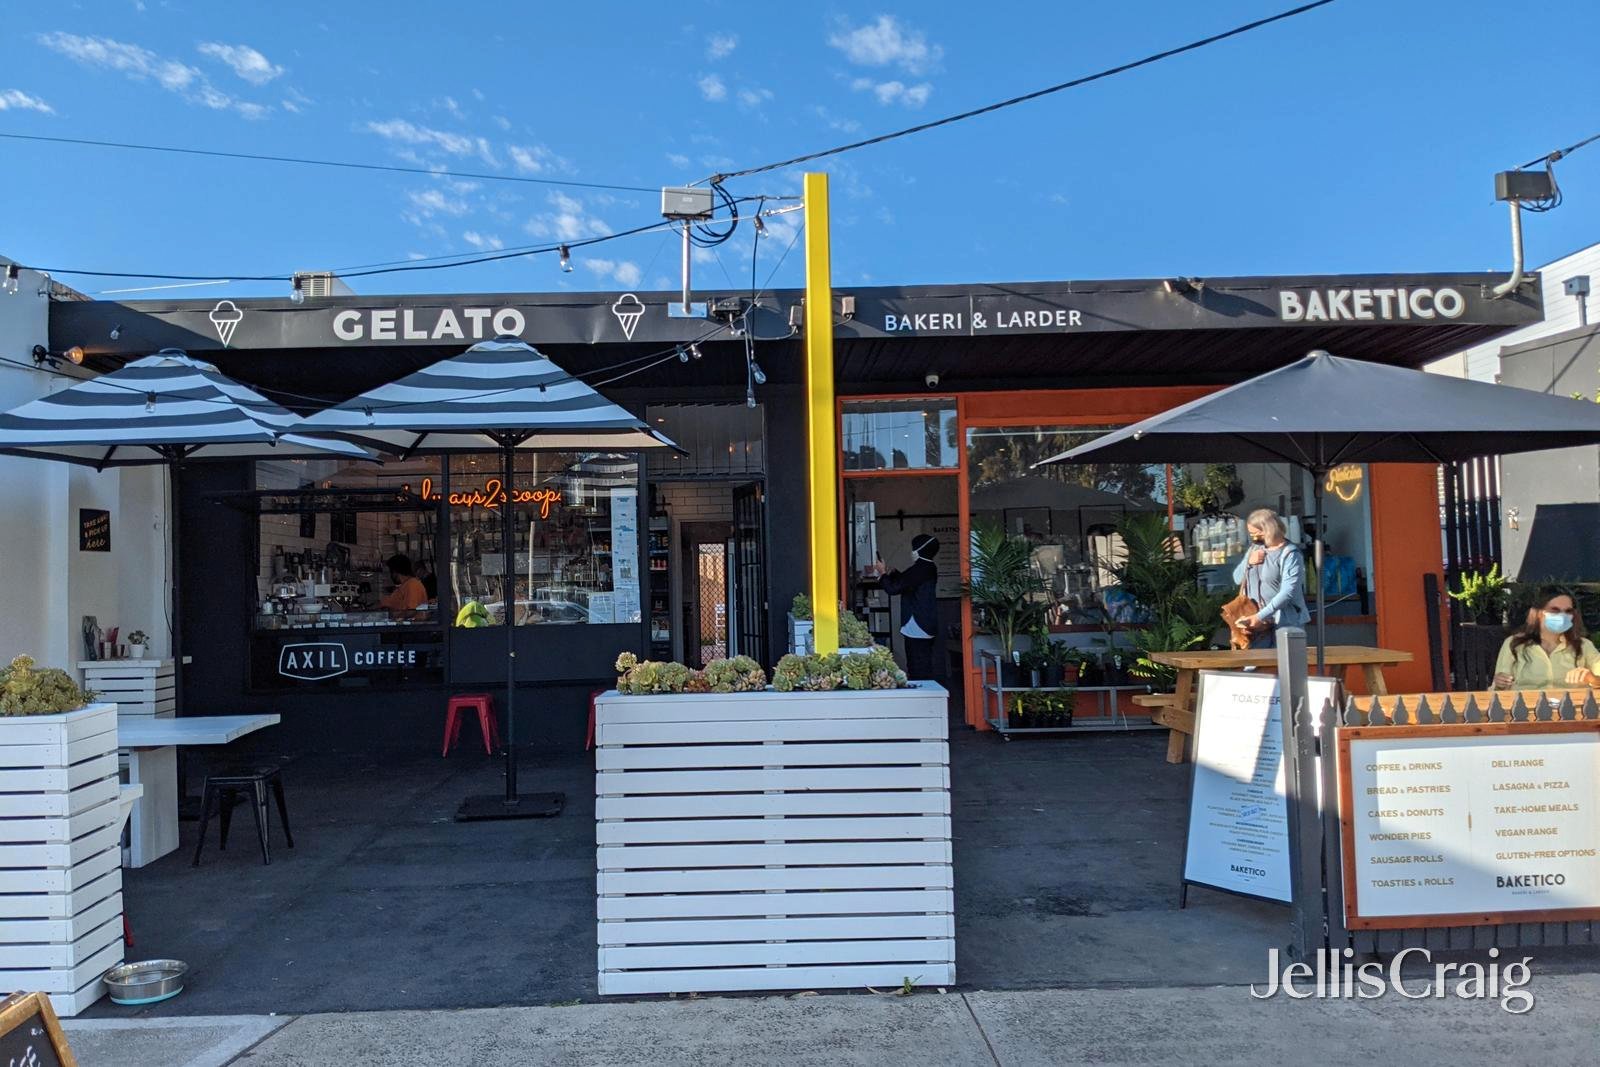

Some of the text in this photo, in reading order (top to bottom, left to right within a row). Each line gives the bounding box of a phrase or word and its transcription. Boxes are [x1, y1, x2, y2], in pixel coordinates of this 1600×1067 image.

[1279, 288, 1465, 322] BAKETICO
[333, 308, 526, 341] GELATO
[885, 310, 1082, 331] BAKERI & LARDER
[287, 650, 416, 669] AXIL COFFEE
[1366, 763, 1400, 772] COFFEE
[1408, 762, 1442, 771] DRINKS
[1491, 759, 1544, 768] DELI RANGE
[1366, 787, 1398, 796] BREAD
[1407, 785, 1451, 794] PASTRIES
[1493, 783, 1535, 791] LASAGNA
[1368, 810, 1398, 819] CAKES
[1406, 808, 1444, 817] DONUTS
[1494, 804, 1579, 814] TAKE-HOME MEALS
[1369, 832, 1432, 841] WONDER PIES
[1495, 828, 1558, 837] VEGAN RANGE
[1370, 855, 1444, 865] SAUSAGE ROLLS
[1496, 849, 1596, 860] GLUTEN-FREE OPTIONS
[1230, 864, 1266, 877] BAKETICO
[1371, 879, 1416, 888] TOASTIES
[1424, 878, 1455, 887] ROLLS
[1496, 874, 1565, 888] BAKETICO
